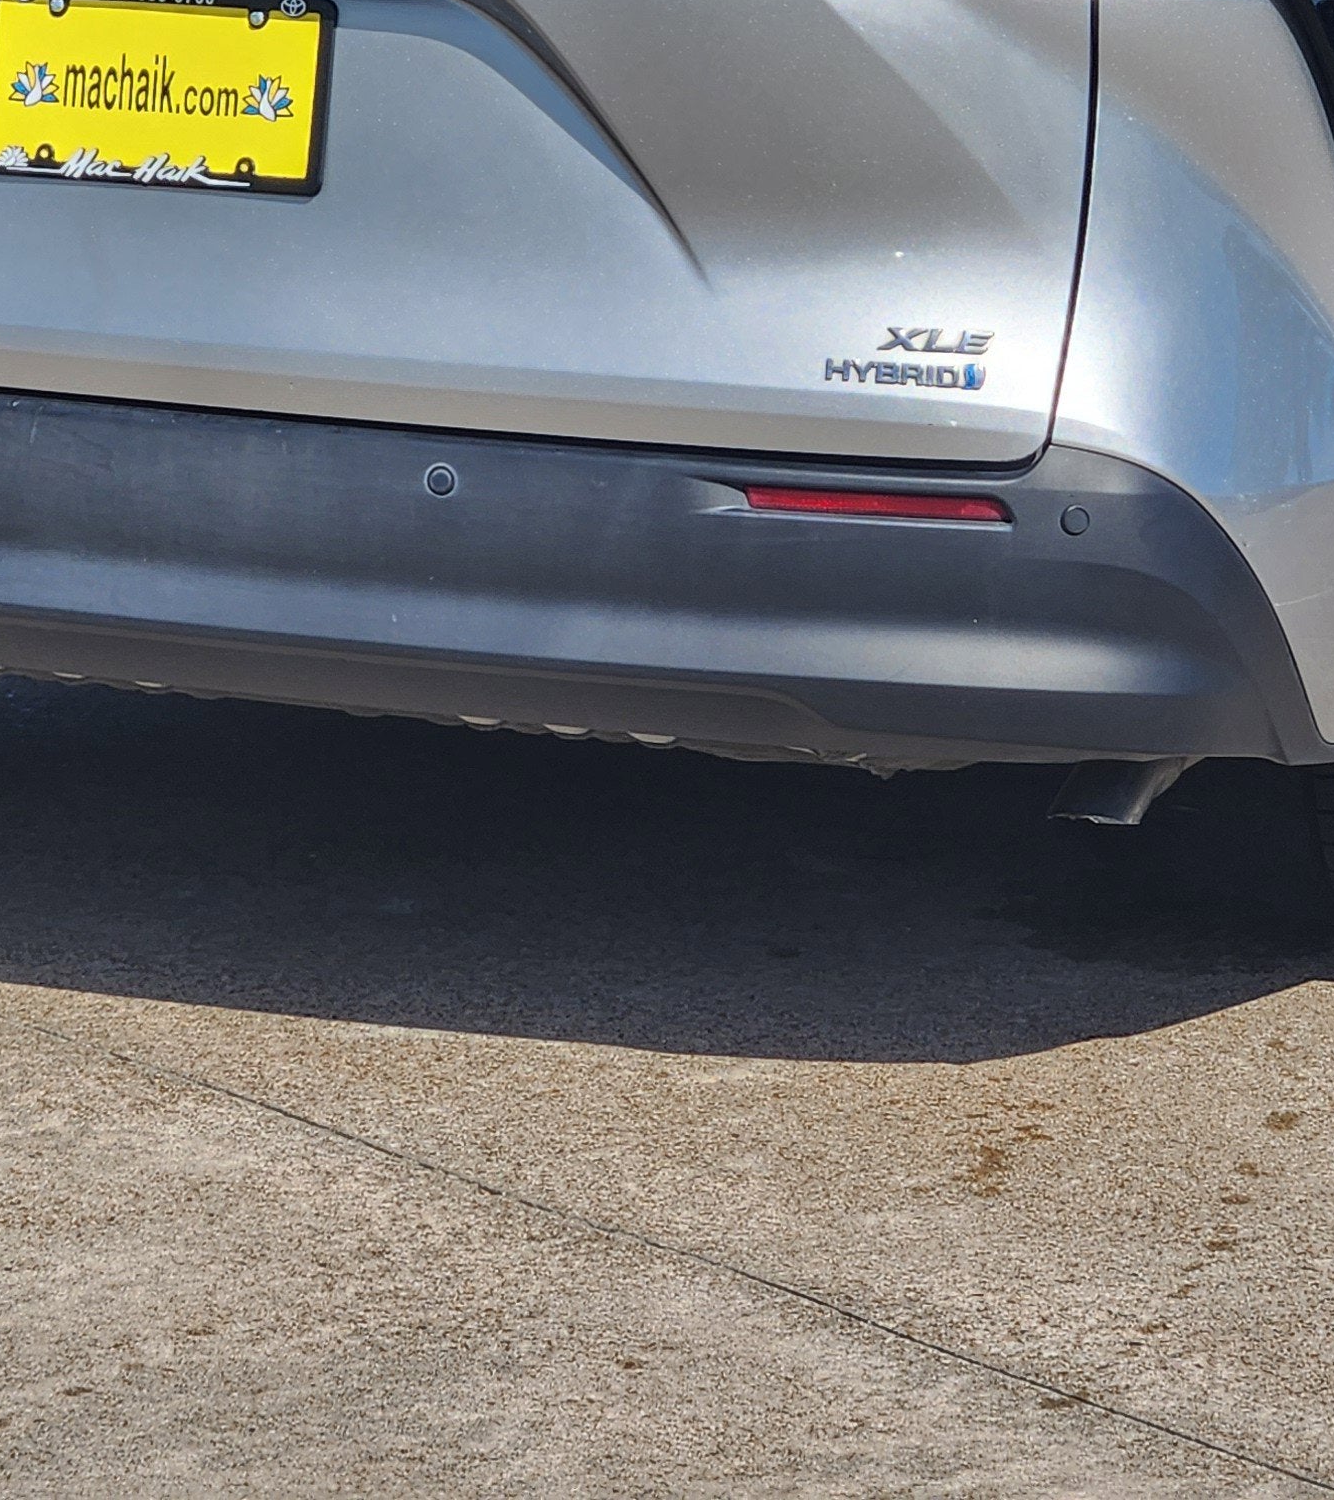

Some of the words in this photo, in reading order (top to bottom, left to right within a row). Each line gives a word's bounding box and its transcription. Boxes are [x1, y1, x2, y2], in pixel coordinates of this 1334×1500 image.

[62, 53, 240, 117] machaik.com
[58, 147, 131, 181] Mac
[131, 153, 251, 186] Haik
[877, 327, 995, 355] XLE
[825, 357, 960, 388] HYBRID
